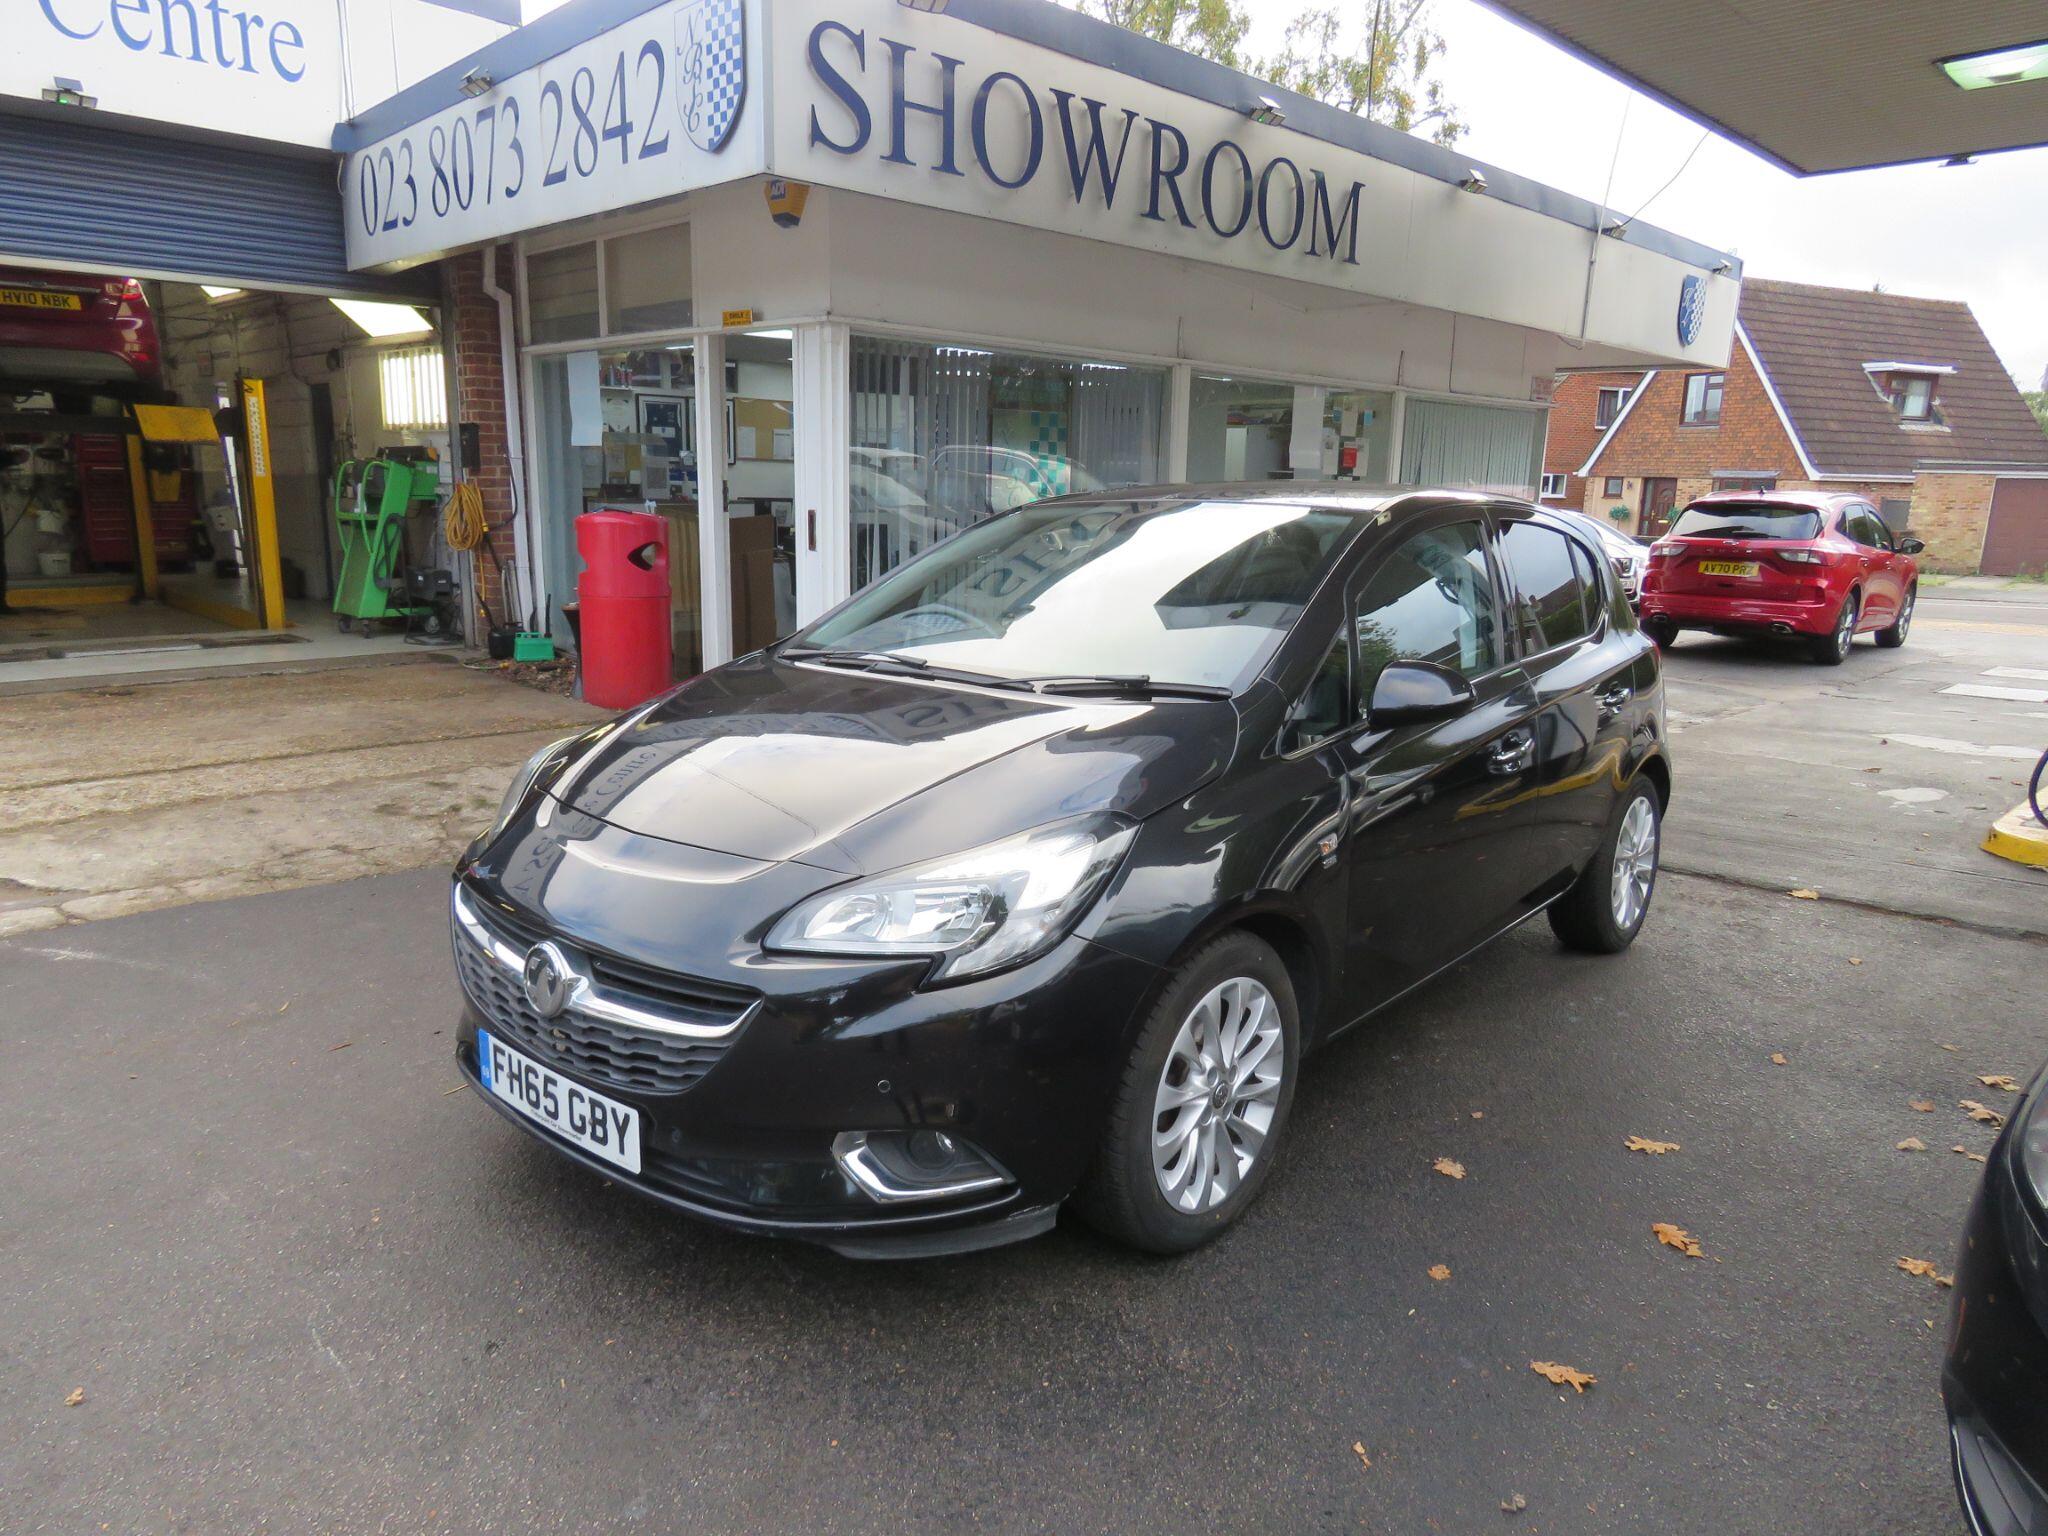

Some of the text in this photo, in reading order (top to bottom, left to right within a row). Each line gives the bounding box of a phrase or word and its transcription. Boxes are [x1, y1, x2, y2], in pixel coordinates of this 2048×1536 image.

[360, 39, 670, 236] 023 8073 2842
[807, 20, 1367, 266] SHOWROOM
[41, 294, 72, 308] NBK
[1702, 562, 1731, 574] AV70
[492, 1042, 631, 1157] FH65 GBY
